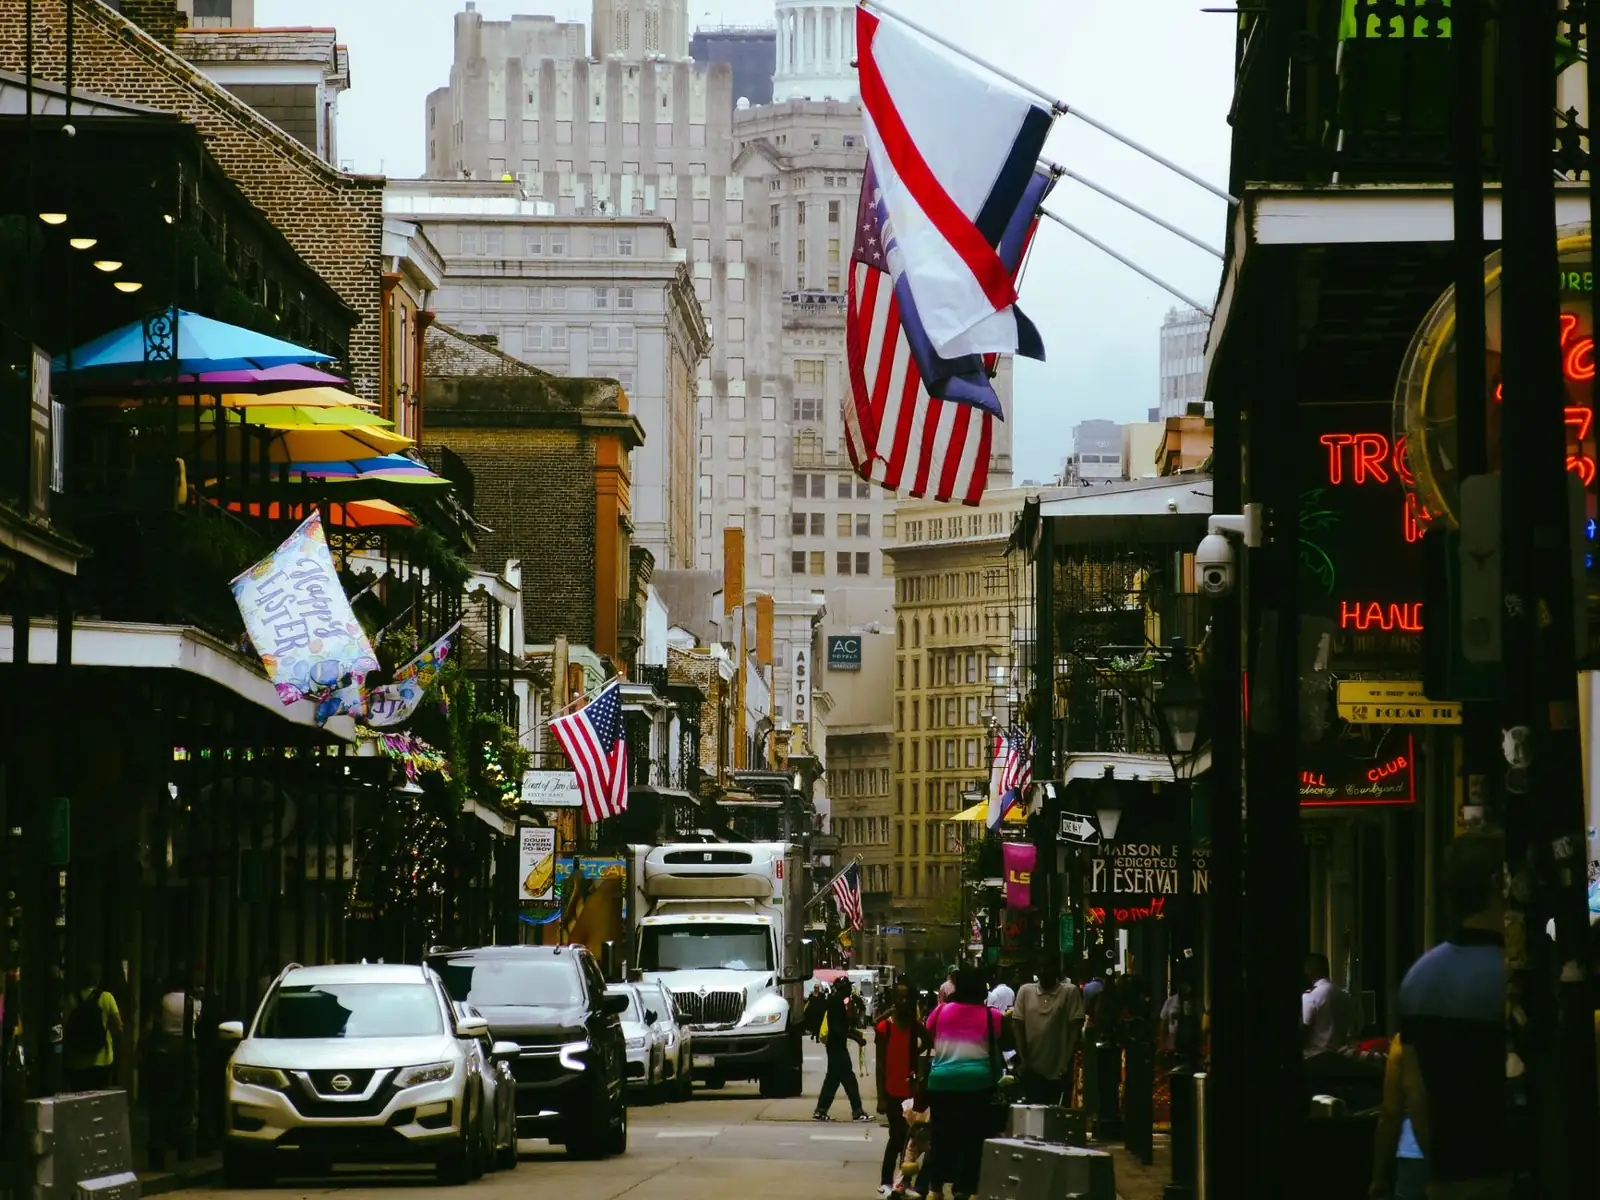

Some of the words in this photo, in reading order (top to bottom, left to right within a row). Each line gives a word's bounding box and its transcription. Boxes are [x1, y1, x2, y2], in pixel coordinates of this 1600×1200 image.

[254, 569, 311, 658] EASTER
[289, 557, 350, 639] Happy
[833, 640, 857, 654] AC
[796, 650, 806, 721] ASTOR
[1375, 707, 1426, 719] KODAK
[1366, 756, 1408, 782] CLUB
